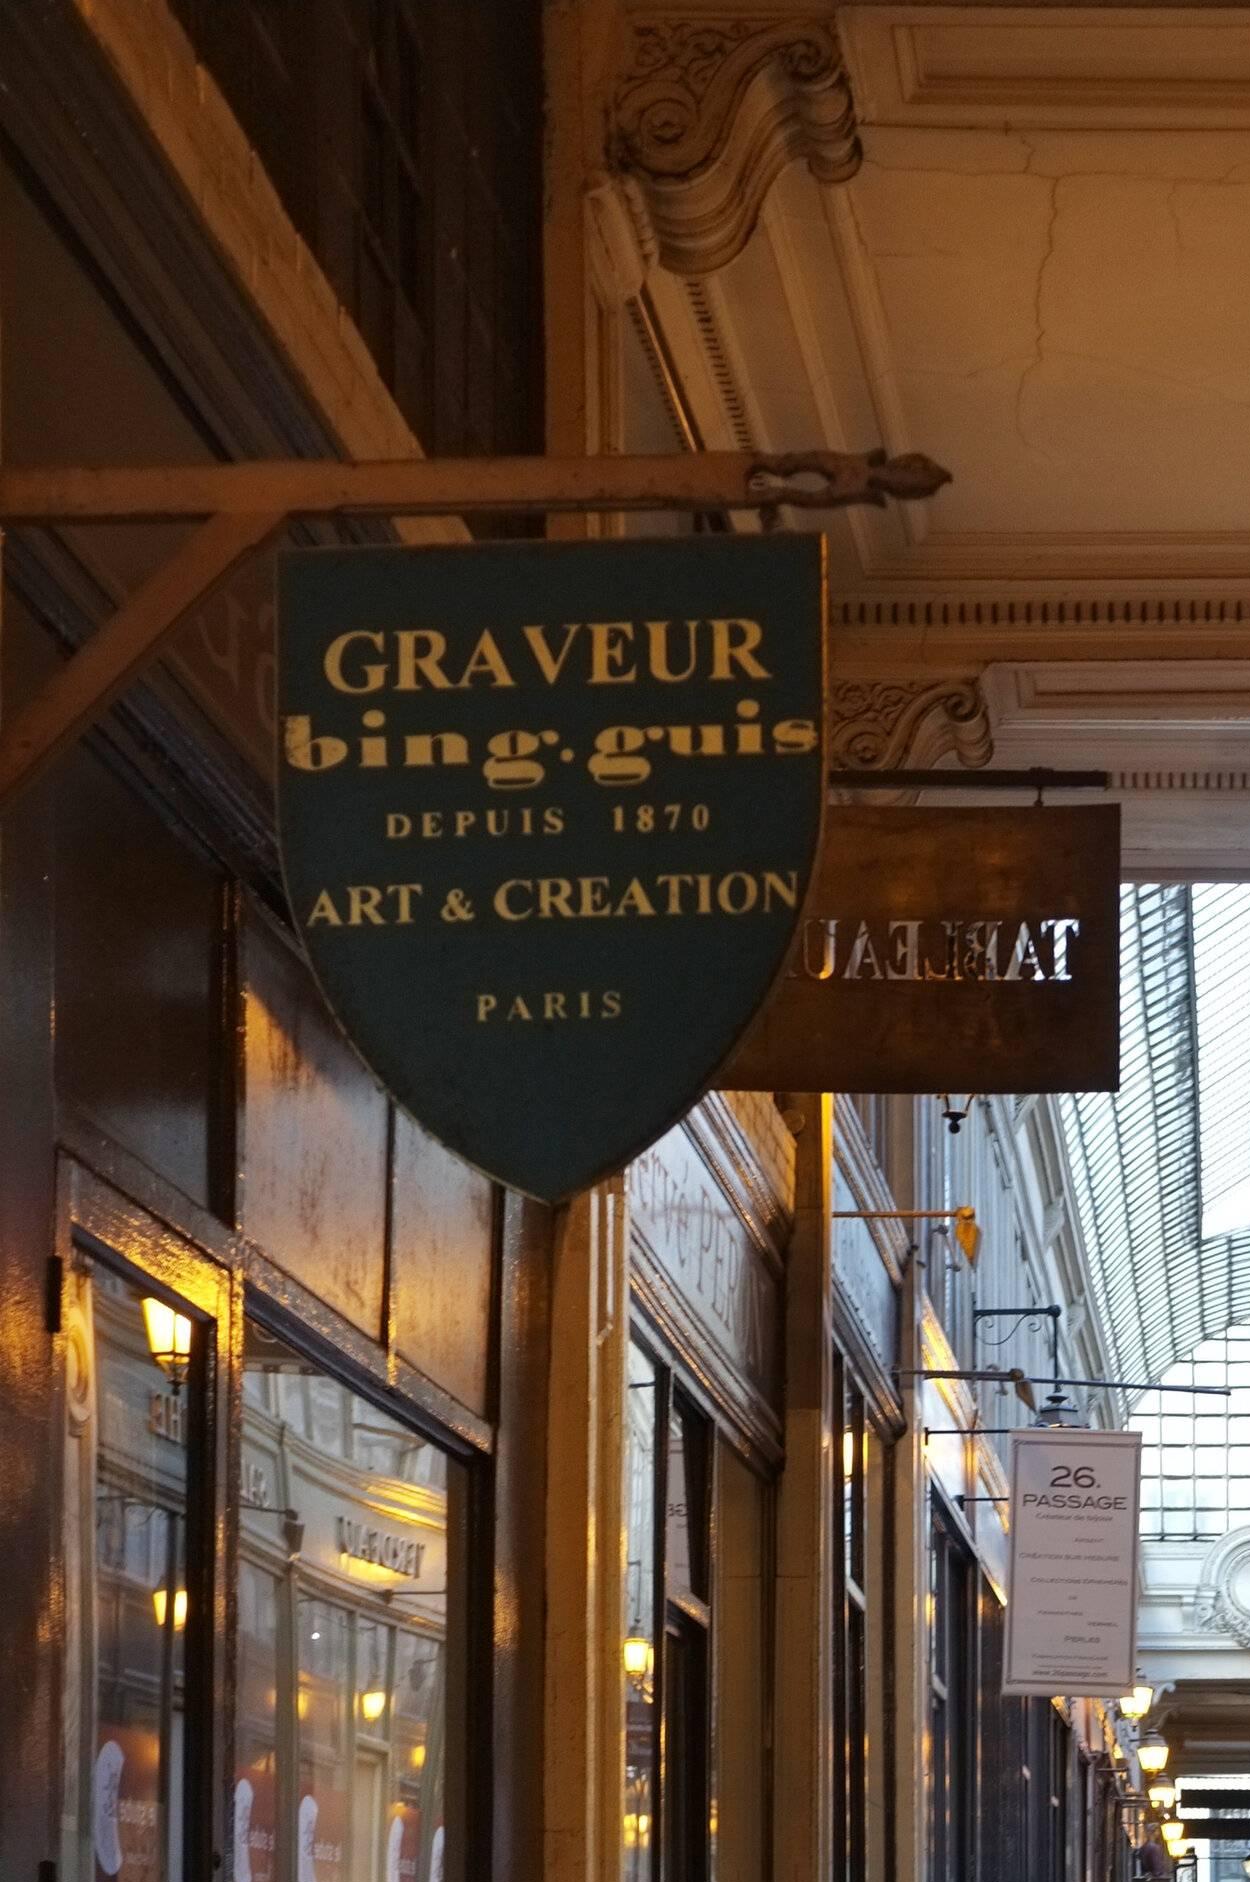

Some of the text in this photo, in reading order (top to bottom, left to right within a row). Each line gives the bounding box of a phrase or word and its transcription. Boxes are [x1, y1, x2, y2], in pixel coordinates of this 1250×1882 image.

[322, 618, 773, 695] GRAVEUR
[386, 804, 711, 840] DEPUIS 1870
[307, 870, 799, 927] ART & CREATION
[476, 990, 624, 1023] PARIS
[1022, 1493, 1128, 1511] PASSAGE
